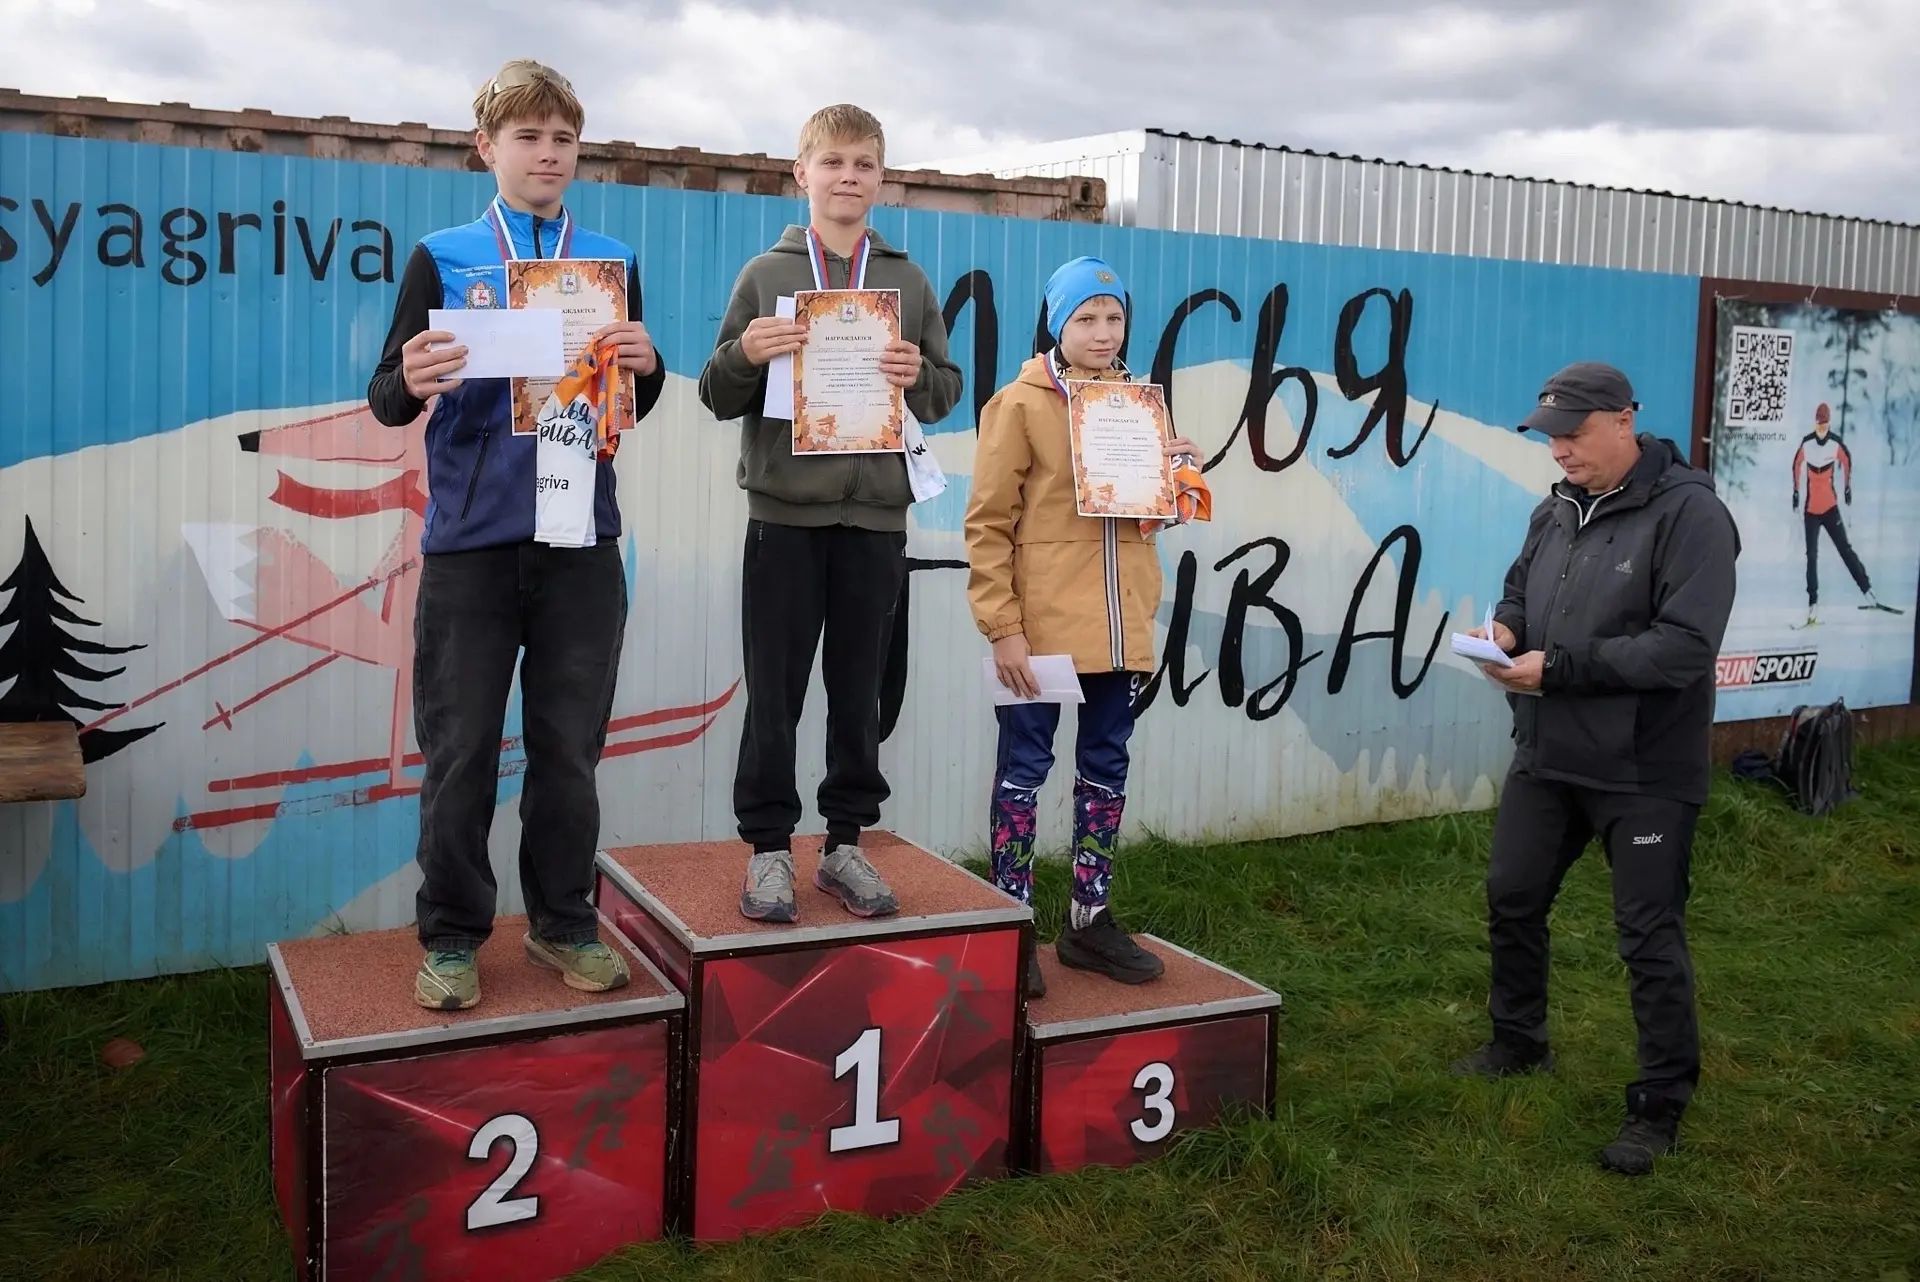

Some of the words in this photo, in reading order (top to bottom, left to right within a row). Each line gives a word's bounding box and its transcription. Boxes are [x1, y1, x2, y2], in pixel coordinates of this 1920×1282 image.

[537, 420, 594, 450] РИВА
[830, 1028, 900, 1153] 1
[1130, 1062, 1175, 1143] 3
[466, 1114, 540, 1230] 2
